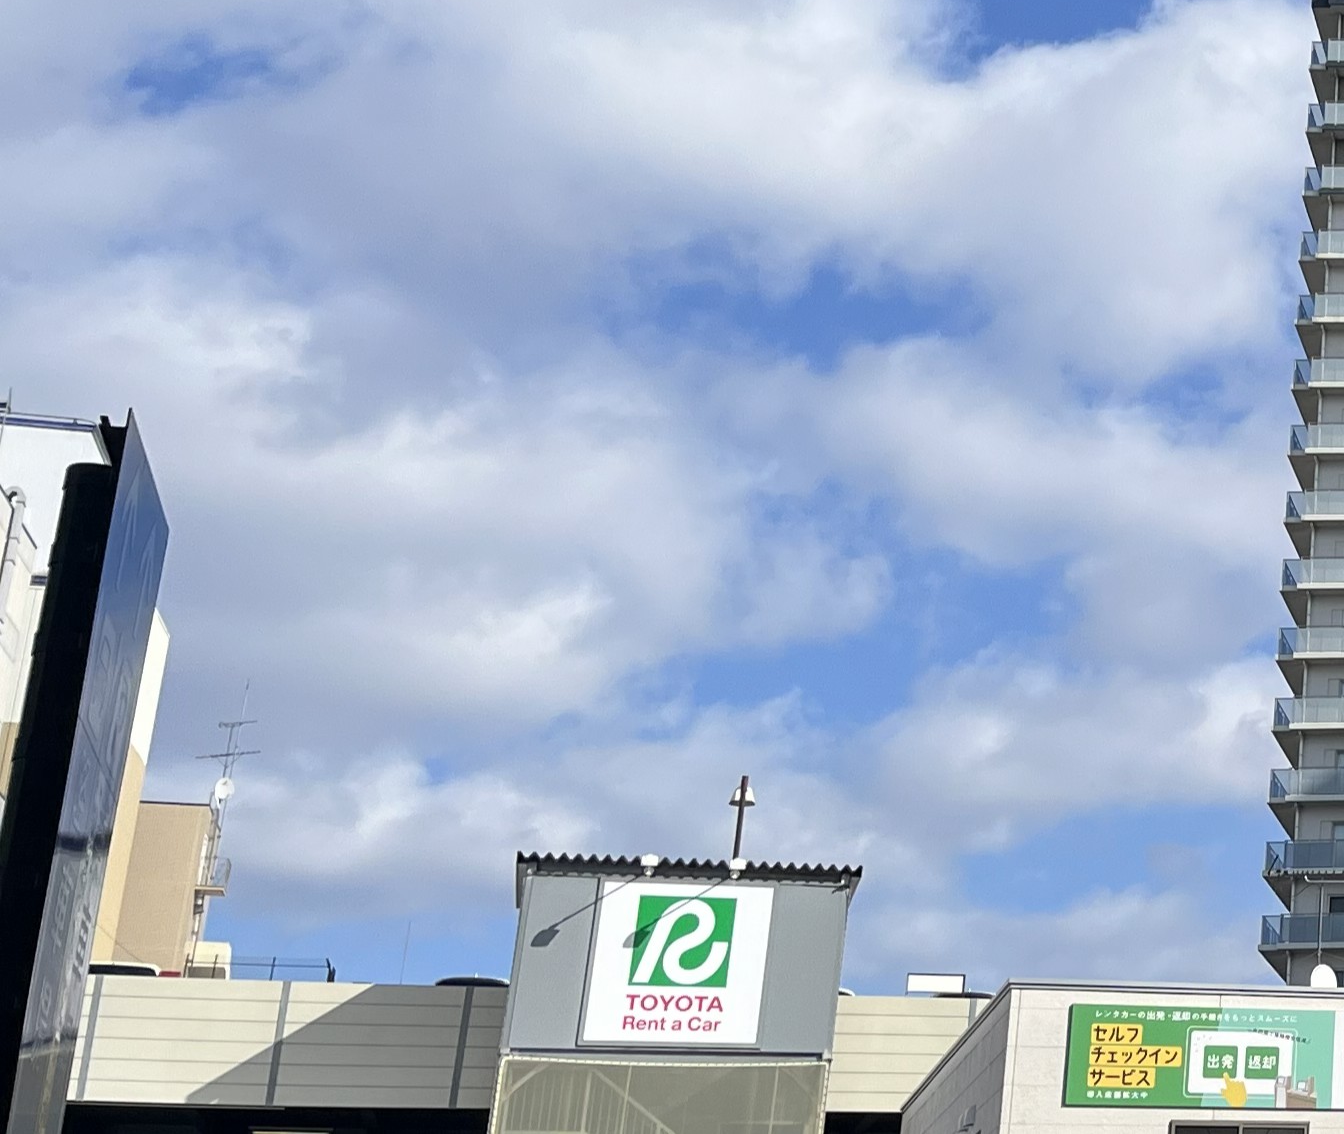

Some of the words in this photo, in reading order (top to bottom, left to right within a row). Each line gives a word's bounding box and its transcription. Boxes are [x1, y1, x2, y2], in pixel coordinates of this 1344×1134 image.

[626, 993, 724, 1013] TOYOTA
[622, 1015, 667, 1031] Rent
[671, 1019, 682, 1031] a
[688, 1016, 721, 1032] Car
[1092, 1025, 1140, 1043] セルフ
[1091, 1047, 1179, 1065] チェックイン
[1206, 1053, 1235, 1070] 出発
[1247, 1054, 1277, 1070] 返却
[1089, 1068, 1151, 1087] サービス
